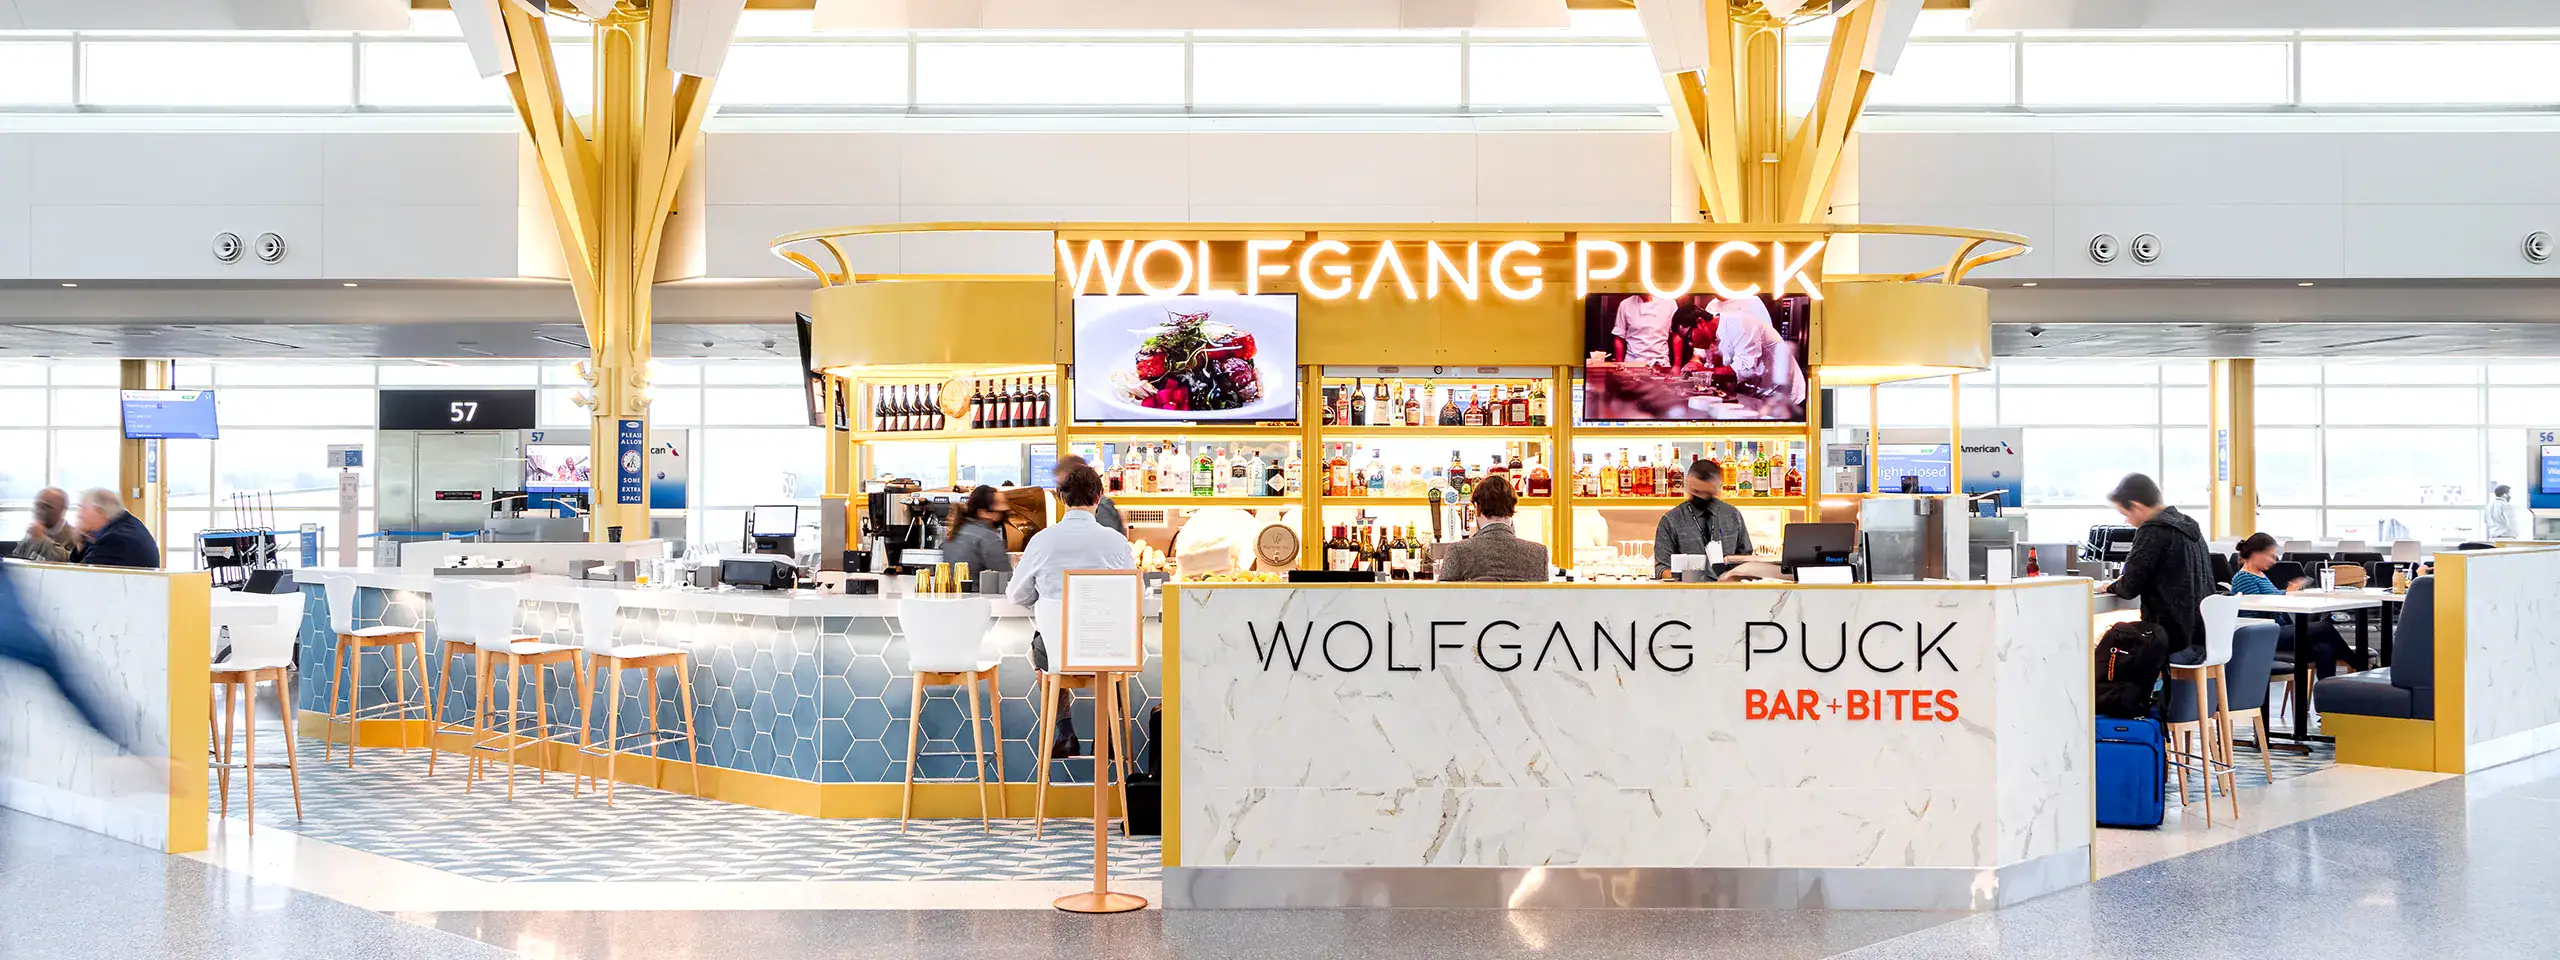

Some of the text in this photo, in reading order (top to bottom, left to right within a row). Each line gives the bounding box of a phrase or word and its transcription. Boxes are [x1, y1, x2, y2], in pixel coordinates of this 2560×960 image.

[1056, 239, 1826, 300] WOLFGANG PUCK
[451, 402, 478, 422] 57
[532, 432, 544, 442] 57
[2540, 432, 2554, 442] 56
[1961, 445, 2000, 453] American
[1877, 466, 1947, 480] light closed
[1247, 620, 1959, 674] WOLFGANG PUCK
